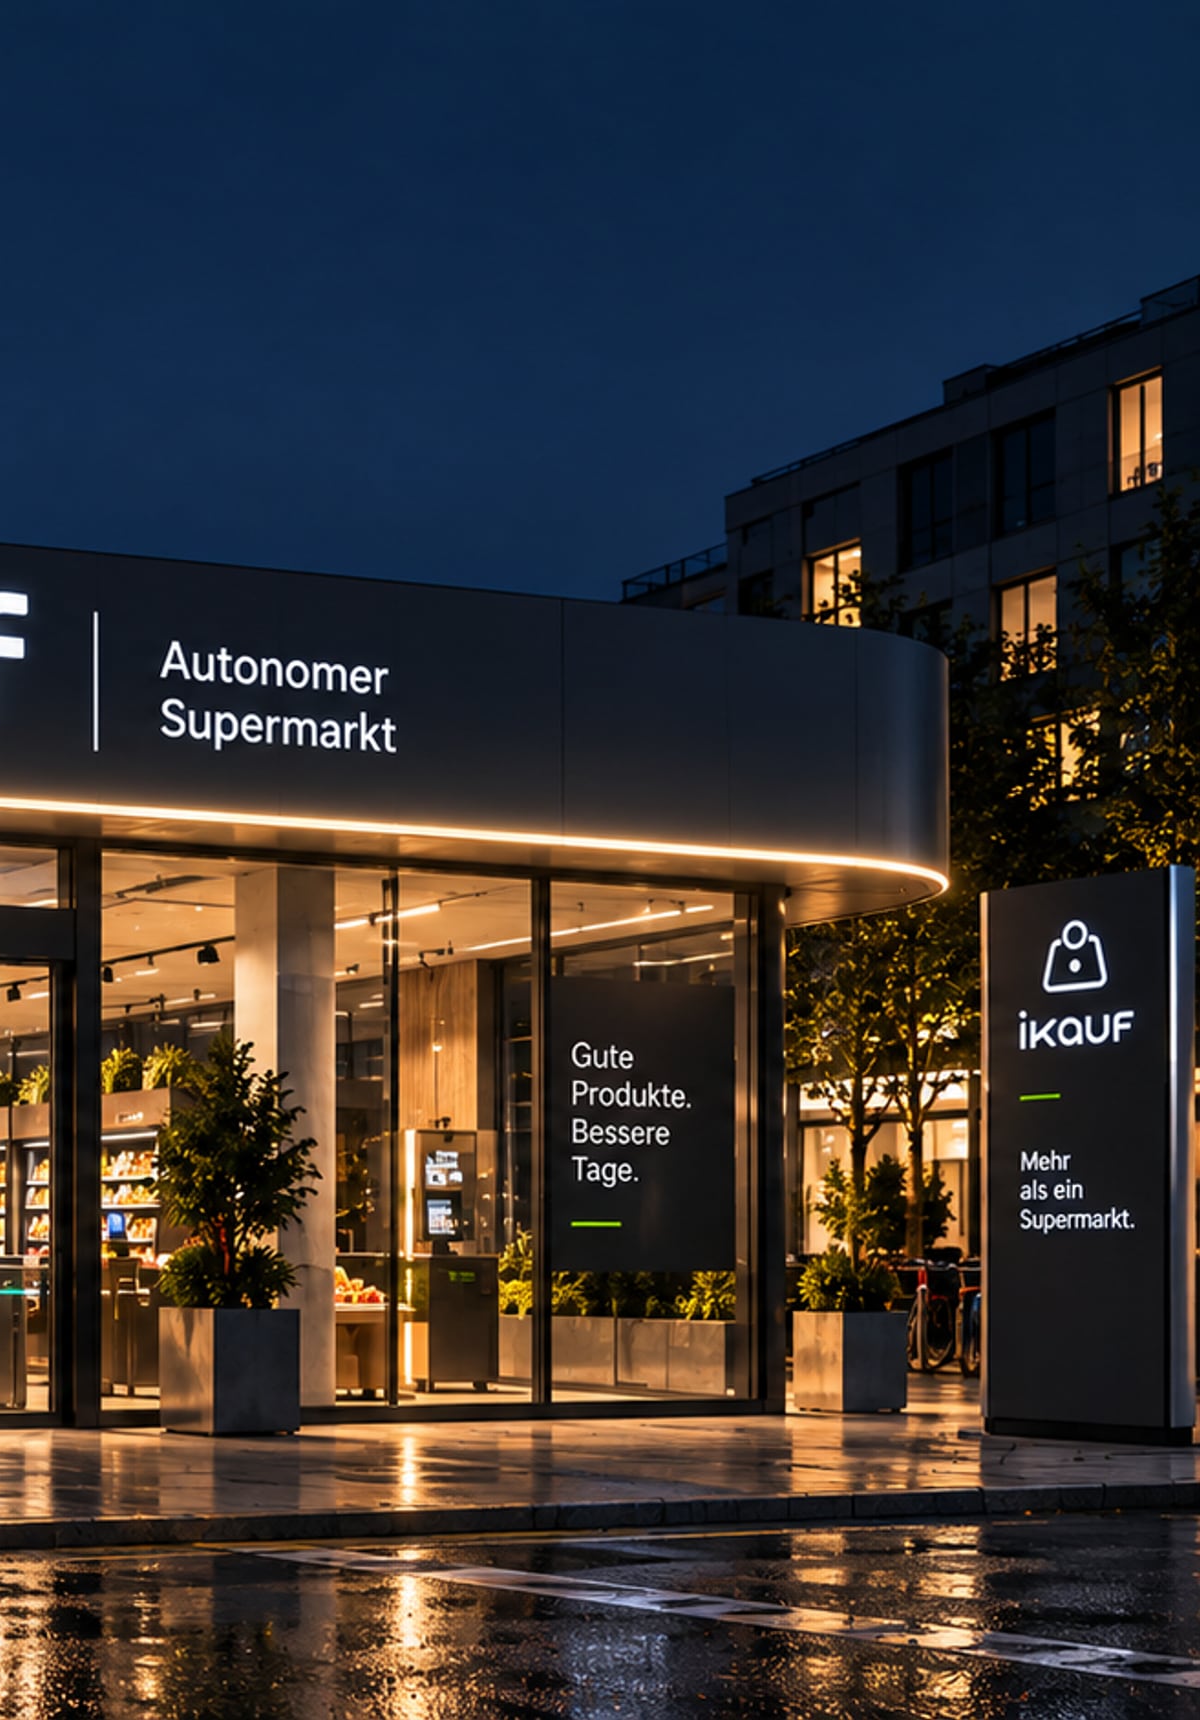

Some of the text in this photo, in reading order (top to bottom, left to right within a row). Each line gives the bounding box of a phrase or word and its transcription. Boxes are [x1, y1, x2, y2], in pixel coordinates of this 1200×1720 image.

[159, 640, 390, 696] Autonomer
[159, 698, 398, 754] Supermarkt
[571, 1041, 634, 1070] Gute
[572, 1080, 692, 1109] Produkte.
[572, 1118, 670, 1146] Bessere
[572, 1155, 639, 1188] Tage.
[1020, 1149, 1071, 1172] Mehr
[1019, 1178, 1084, 1201] als ein
[1019, 1207, 1135, 1235] Supermarkt.
